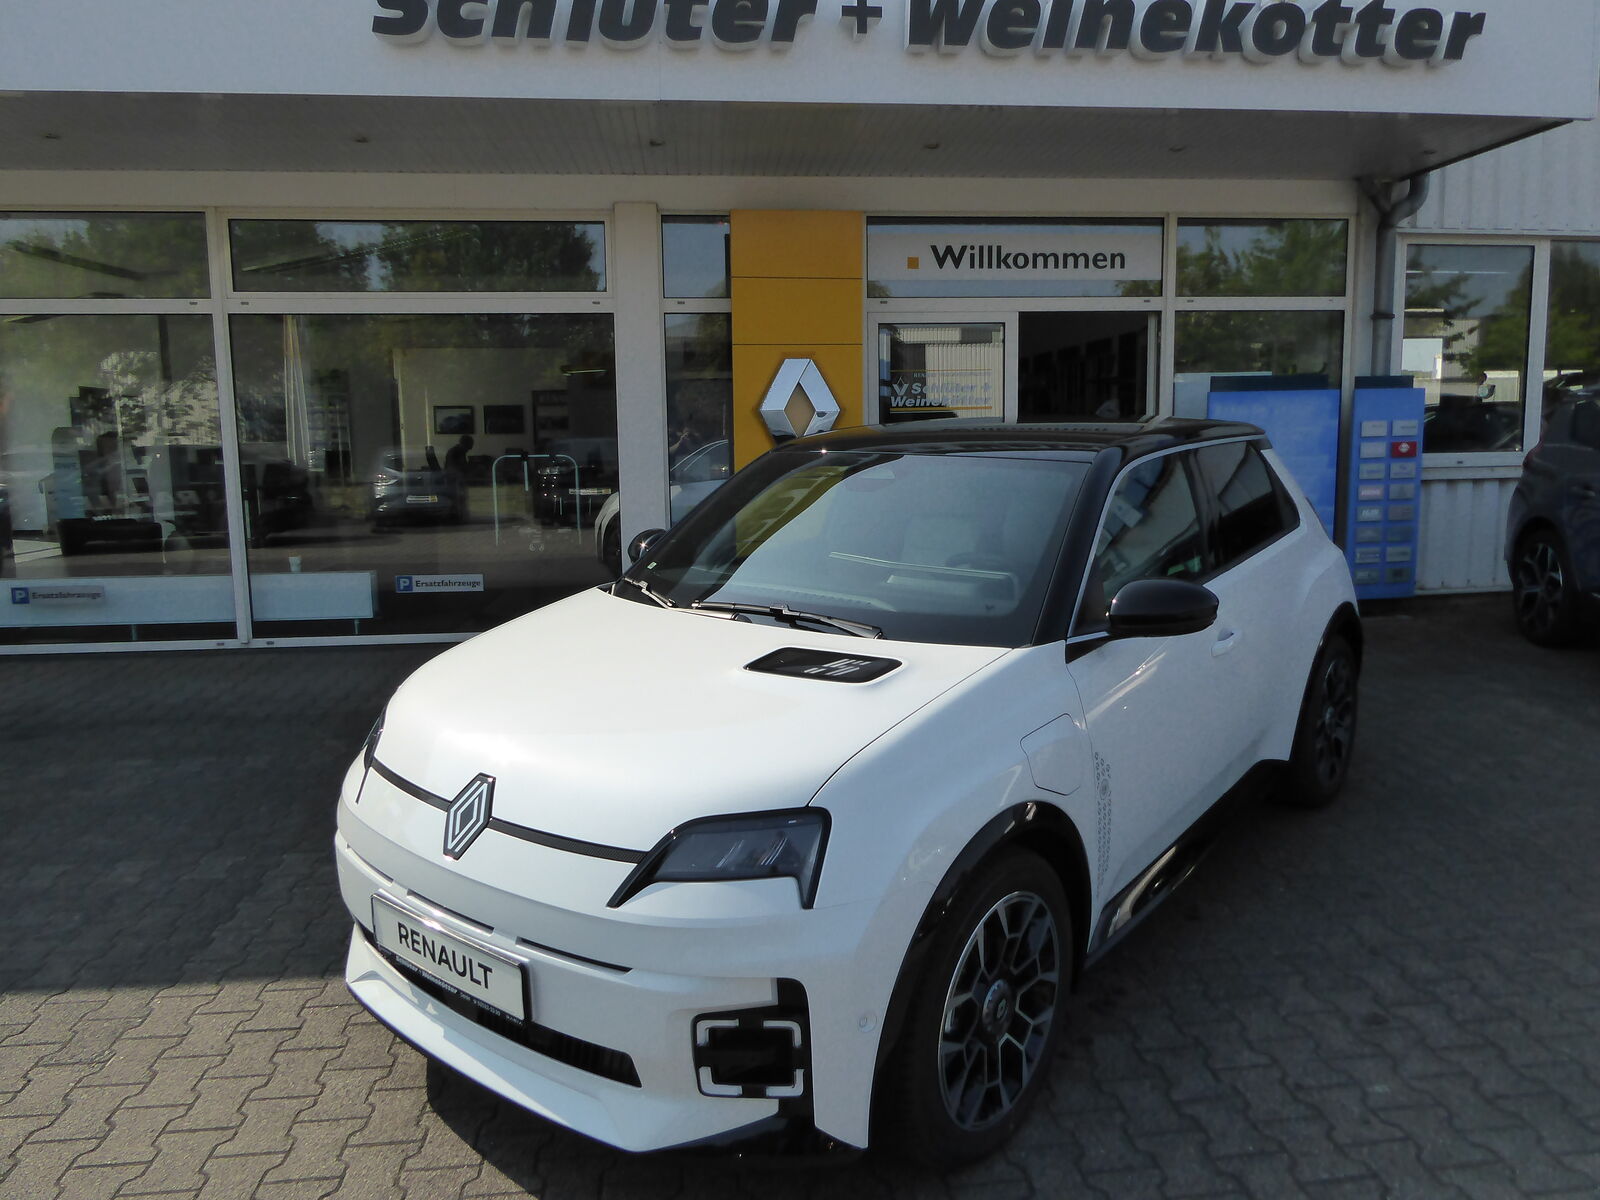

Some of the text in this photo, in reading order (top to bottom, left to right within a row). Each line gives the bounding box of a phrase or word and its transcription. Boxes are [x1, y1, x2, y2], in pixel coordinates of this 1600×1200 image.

[840, 0, 884, 36] +
[930, 245, 1126, 269] Willkommen
[415, 579, 481, 588] Ersatzfahrzeuge
[397, 921, 493, 989] RENAULT
